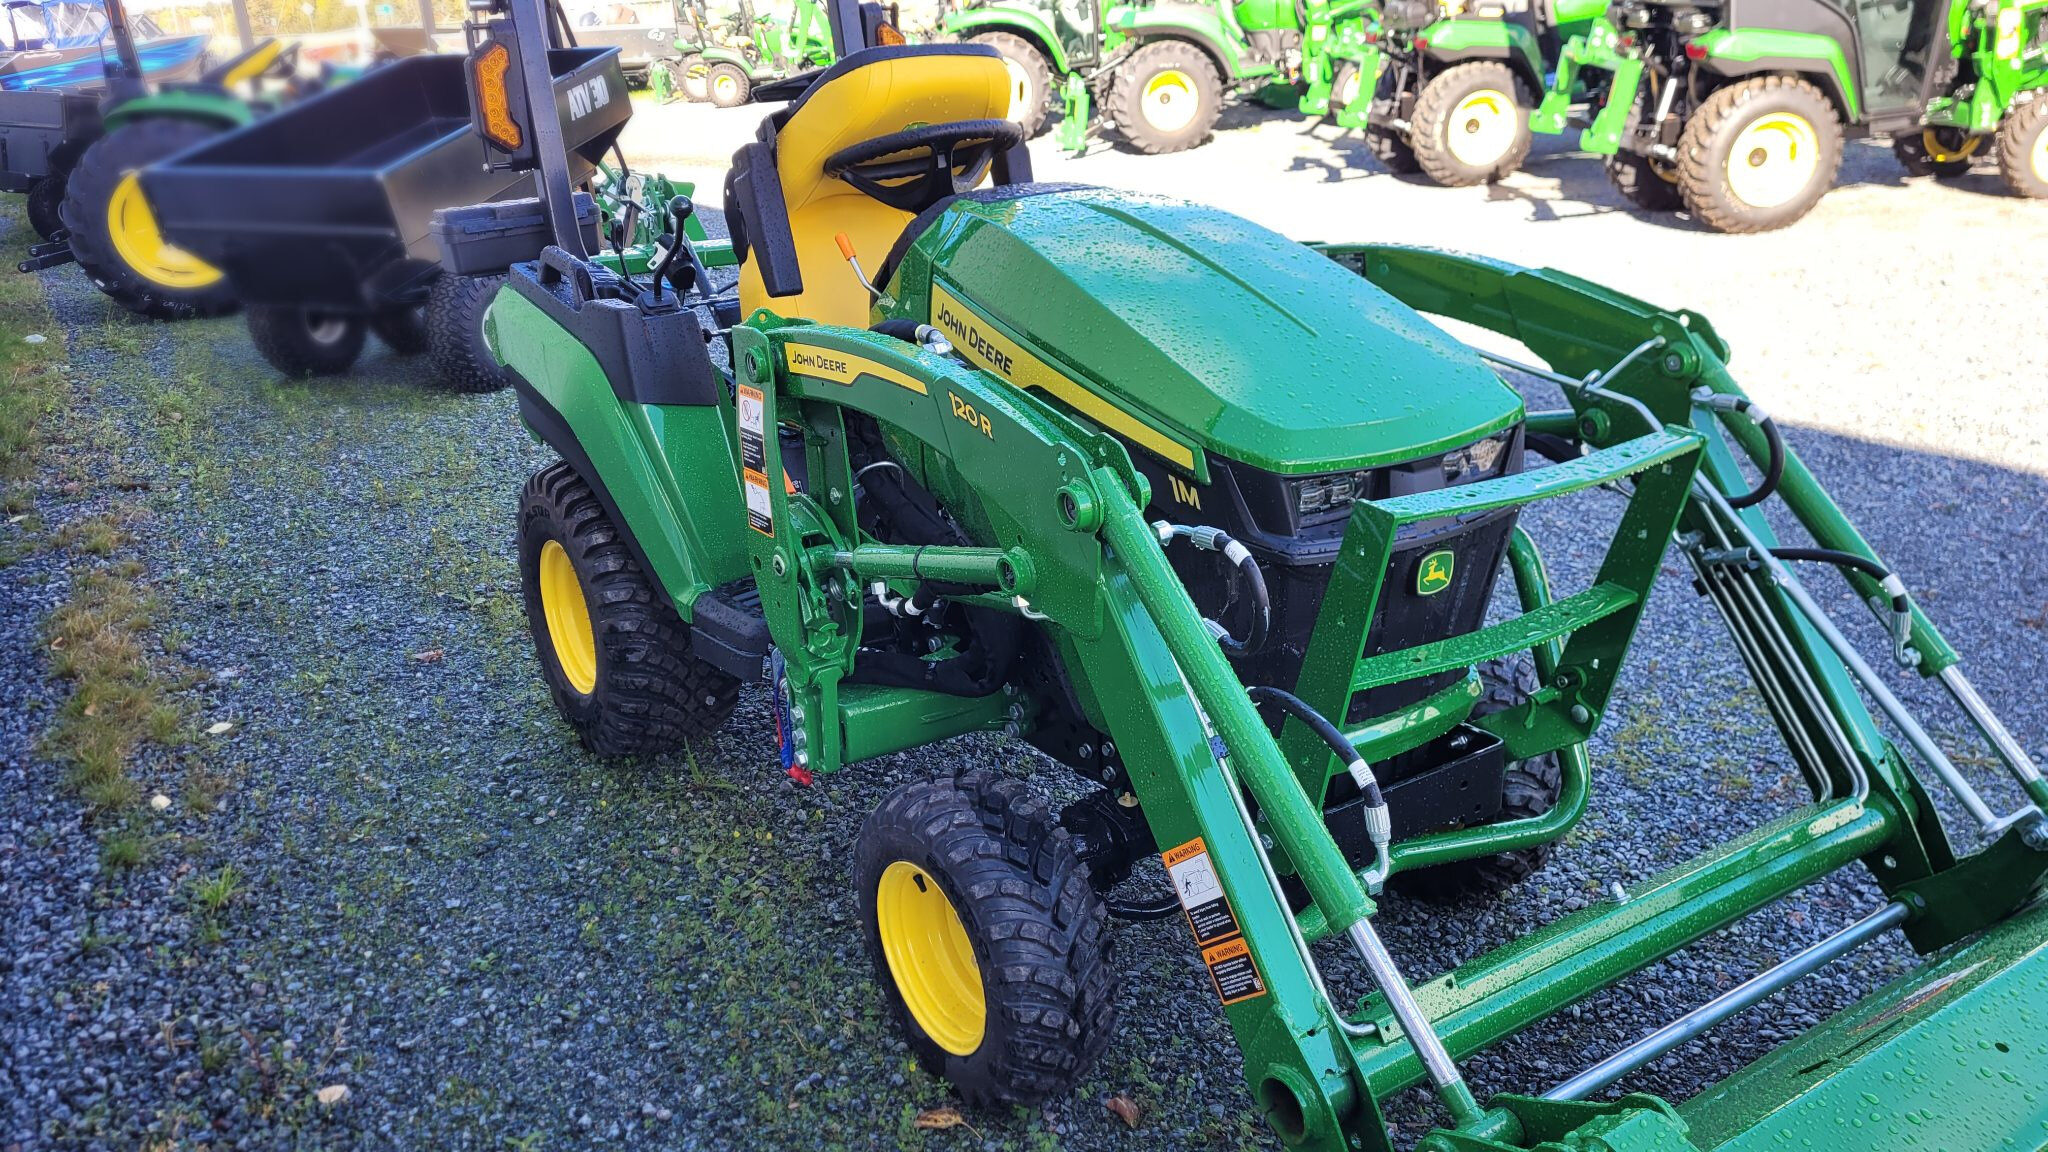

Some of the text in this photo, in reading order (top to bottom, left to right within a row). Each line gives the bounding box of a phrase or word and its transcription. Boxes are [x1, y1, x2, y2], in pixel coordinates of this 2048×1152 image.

[567, 75, 610, 121] ATV 30
[937, 303, 1013, 376] JOHN DEERE
[792, 350, 847, 373] JOHN DEERE
[1167, 473, 1201, 511] 1M
[1174, 843, 1200, 860] WARNING
[1215, 944, 1243, 959] WARNING
